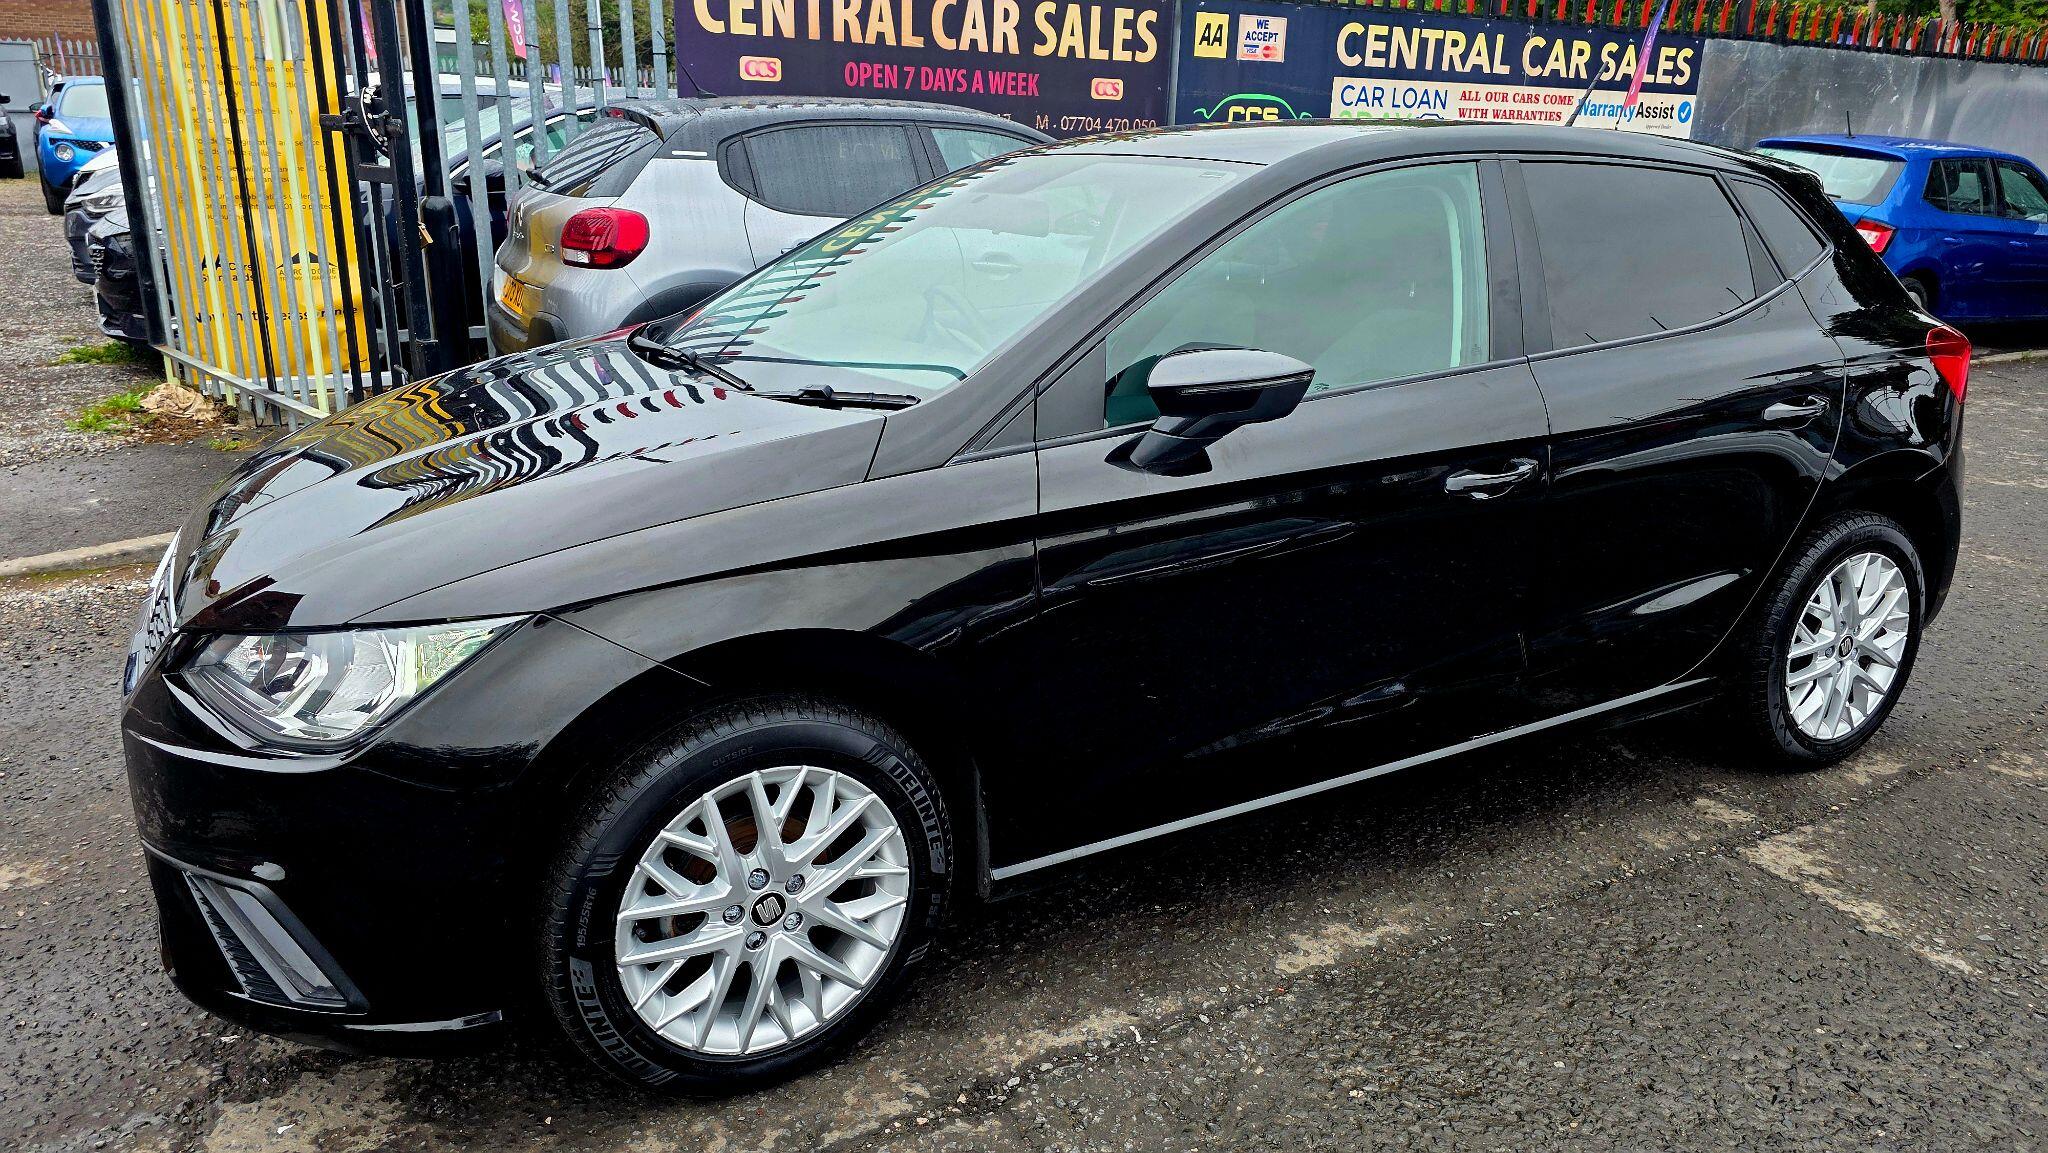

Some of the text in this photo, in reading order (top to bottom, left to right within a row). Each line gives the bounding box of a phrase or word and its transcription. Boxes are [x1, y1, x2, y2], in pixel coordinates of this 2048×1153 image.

[693, 0, 1158, 63] CENTRAL CAR SALES
[1198, 22, 1225, 47] AA
[1256, 18, 1270, 30] WE
[1245, 30, 1279, 42] ACCEPT
[1336, 22, 1511, 75] CENTRAL
[1522, 35, 1591, 79] CAR
[844, 61, 1040, 97] OPEN 7 DAYS A WEEK
[1340, 84, 1448, 110] CAR LOAN
[1459, 90, 1574, 106] ALL OUR CARS COME
[1060, 115, 1101, 131] 07704
[1105, 118, 1129, 132] 470
[1458, 107, 1562, 122] WITH WARRANTIES
[711, 746, 754, 767] OUTSIDE
[888, 761, 944, 854] DELINTE
